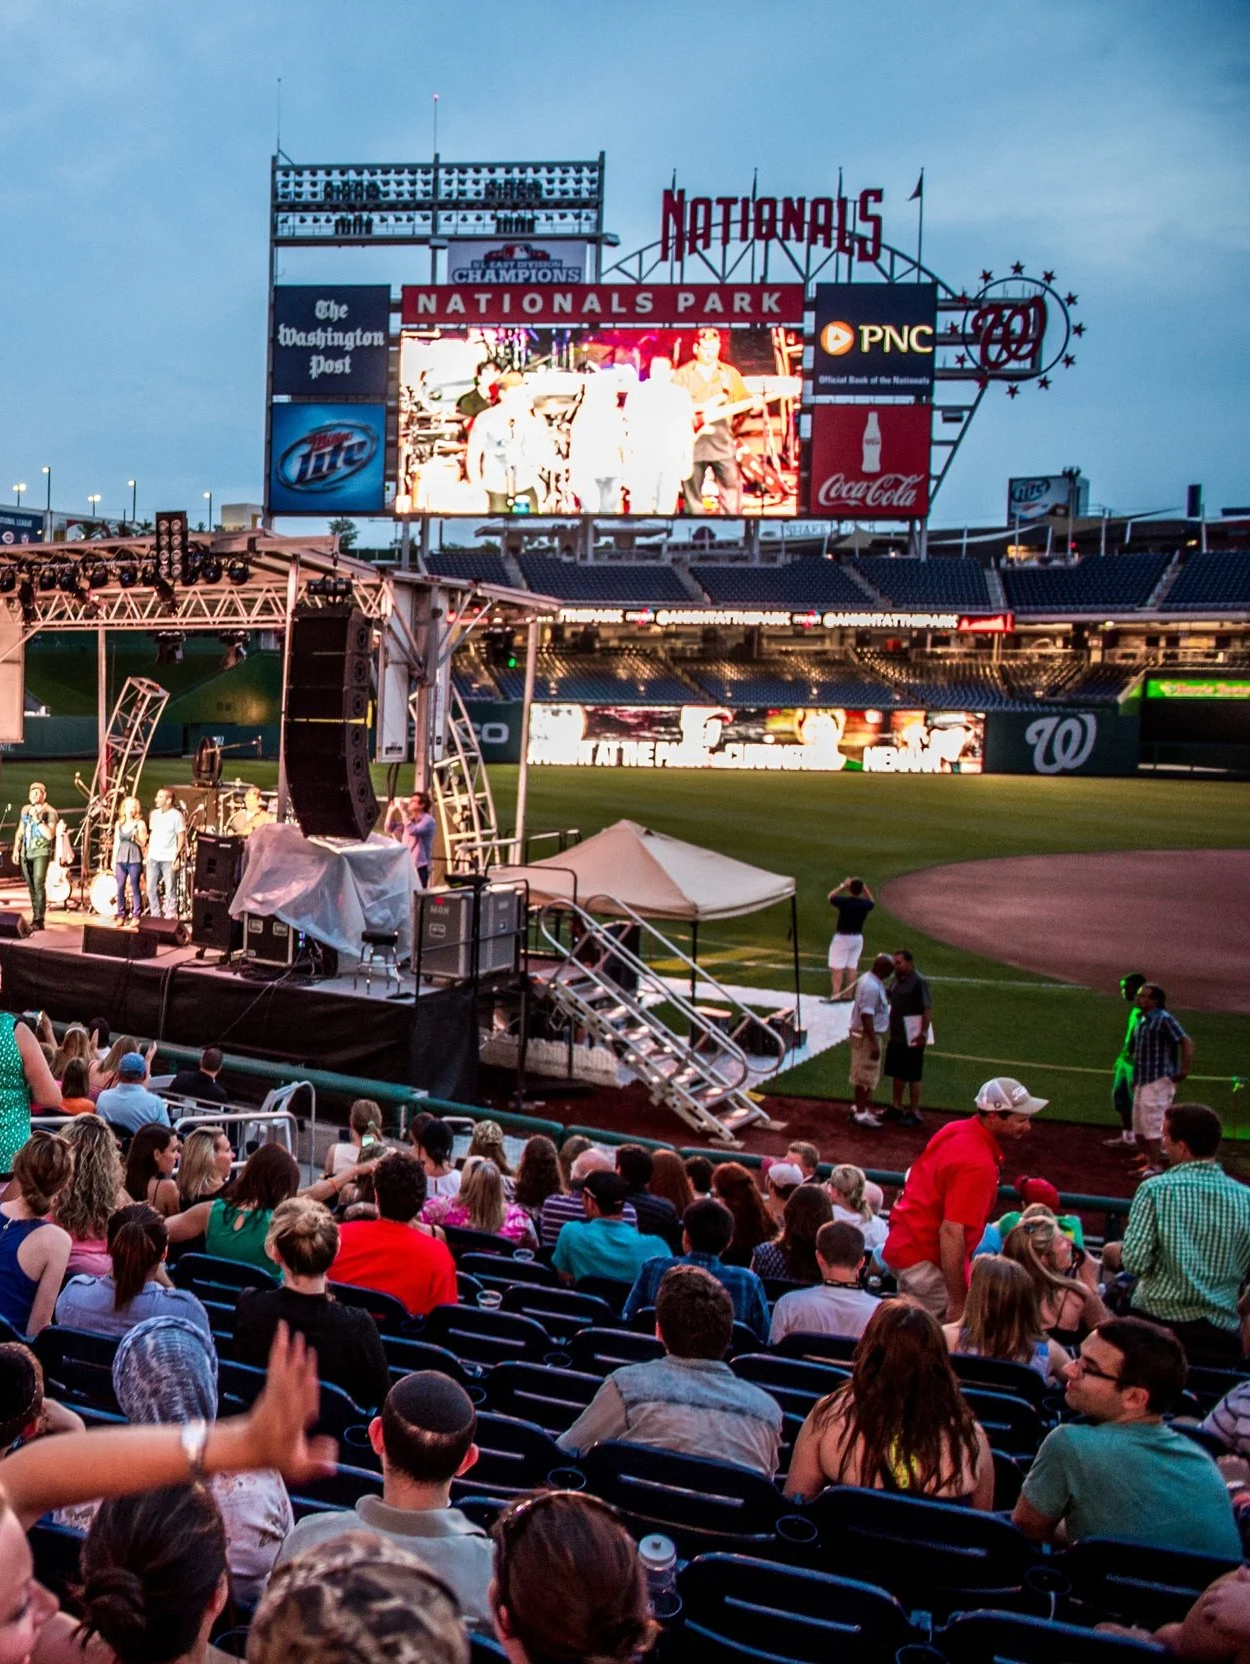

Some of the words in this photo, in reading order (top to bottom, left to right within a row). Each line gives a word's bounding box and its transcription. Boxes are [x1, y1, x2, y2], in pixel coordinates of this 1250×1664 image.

[661, 188, 884, 262] NATIONALS
[453, 268, 581, 284] CHAMPIONS
[314, 299, 349, 322] The
[418, 293, 654, 314] NATIONALS
[677, 293, 782, 314] PARK
[277, 322, 385, 352] Washington
[858, 324, 934, 354] PNC
[309, 354, 352, 380] Post
[818, 374, 848, 385] Official
[849, 374, 869, 385] Bank
[870, 374, 879, 385] of
[879, 374, 893, 385] the
[893, 374, 930, 385] Nationals
[294, 440, 369, 486] Lite
